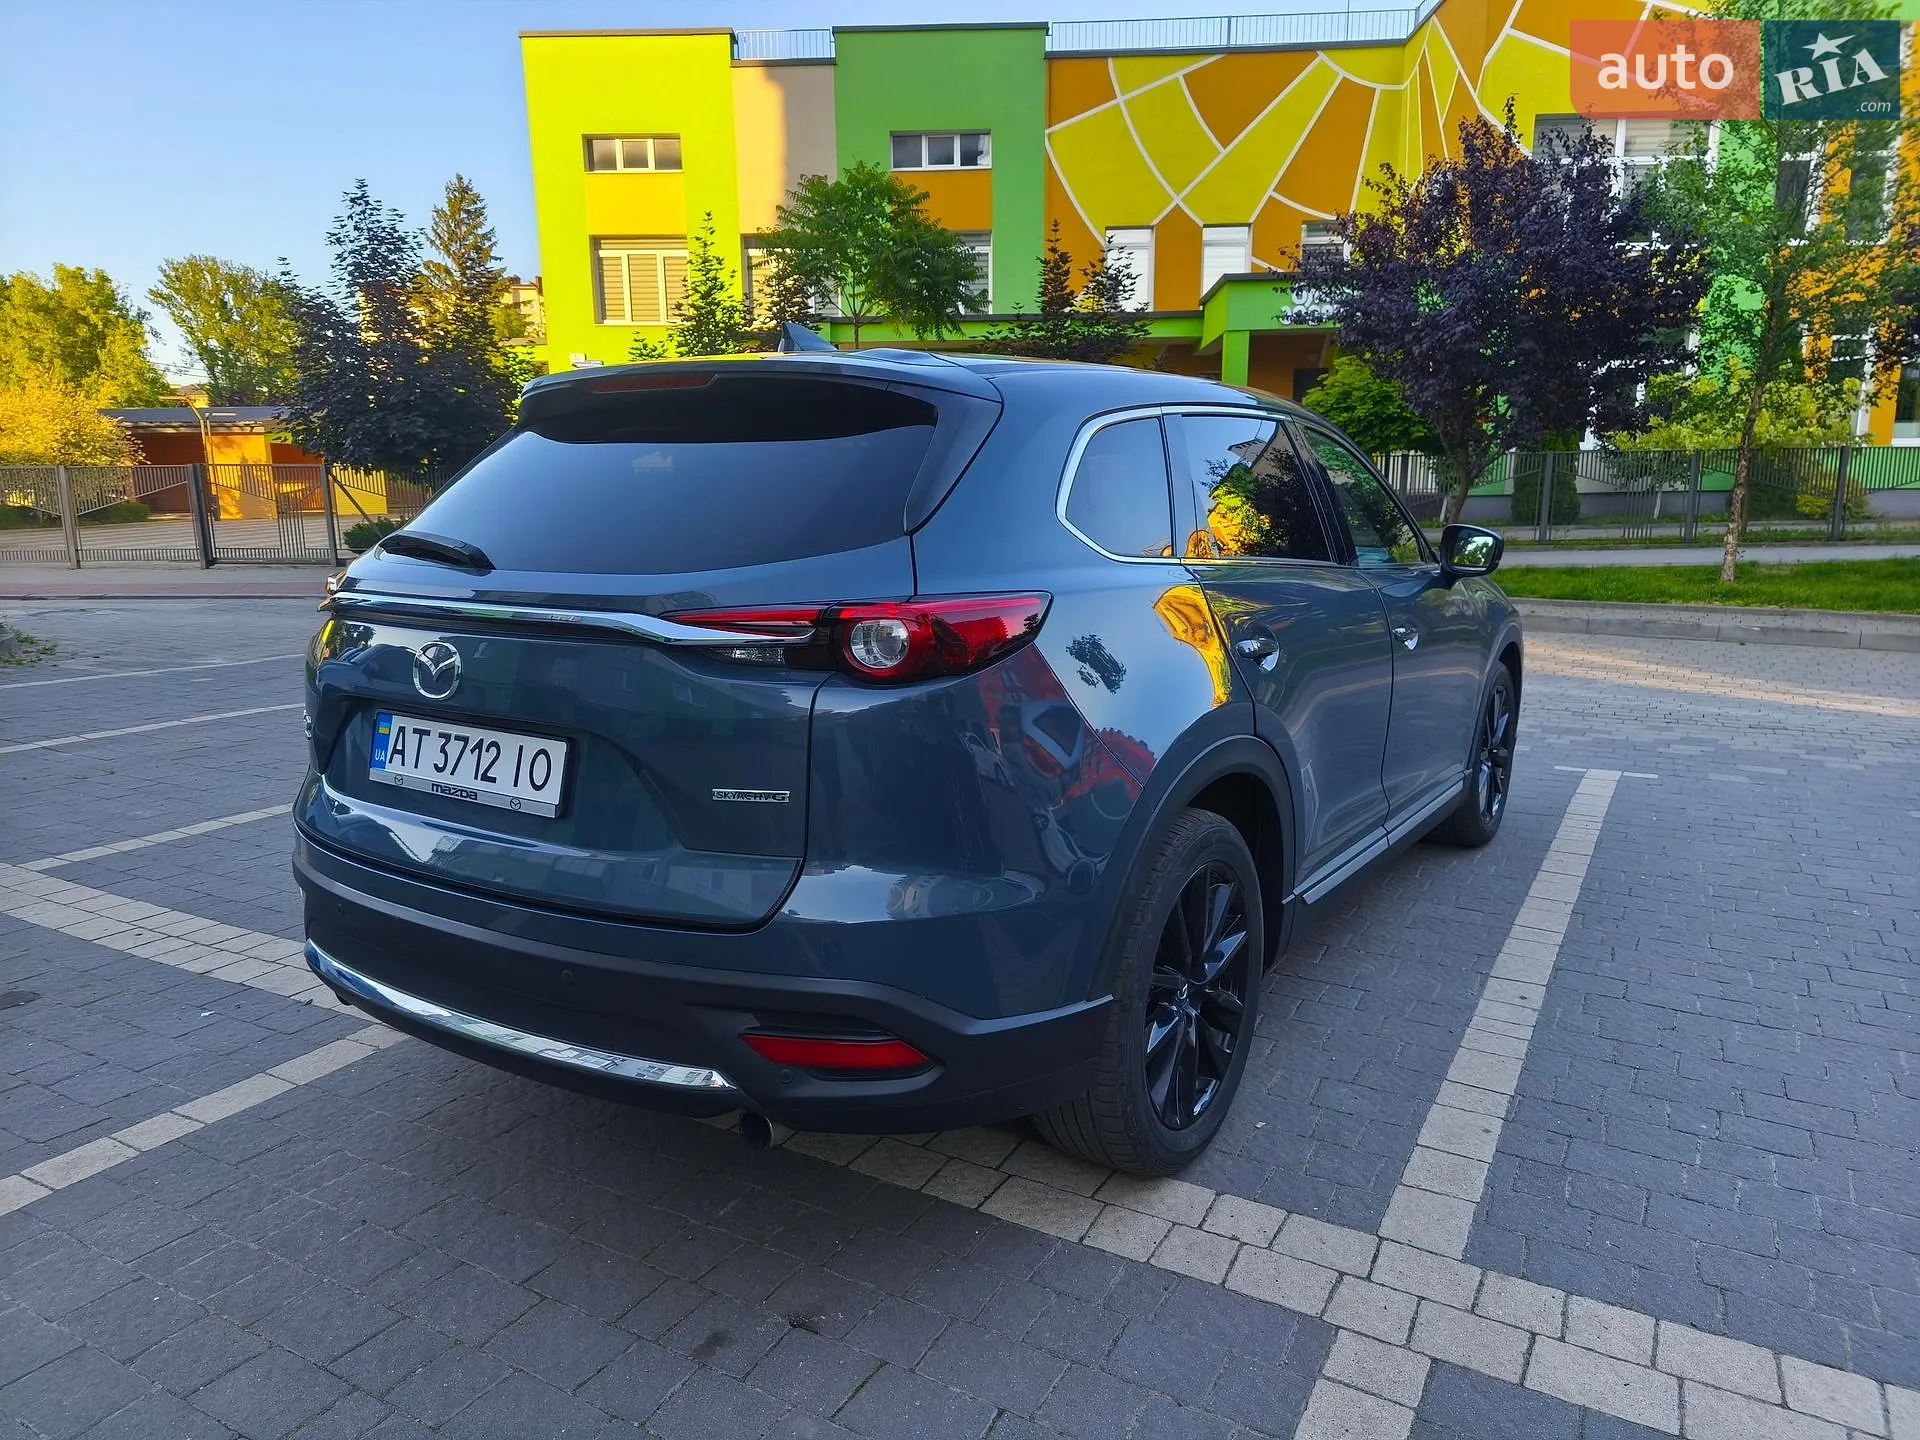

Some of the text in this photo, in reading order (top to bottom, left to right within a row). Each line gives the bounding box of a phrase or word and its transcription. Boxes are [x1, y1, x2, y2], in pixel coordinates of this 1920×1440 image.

[375, 749, 385, 762] UA
[388, 725, 431, 769] AT
[433, 731, 502, 784] 3712
